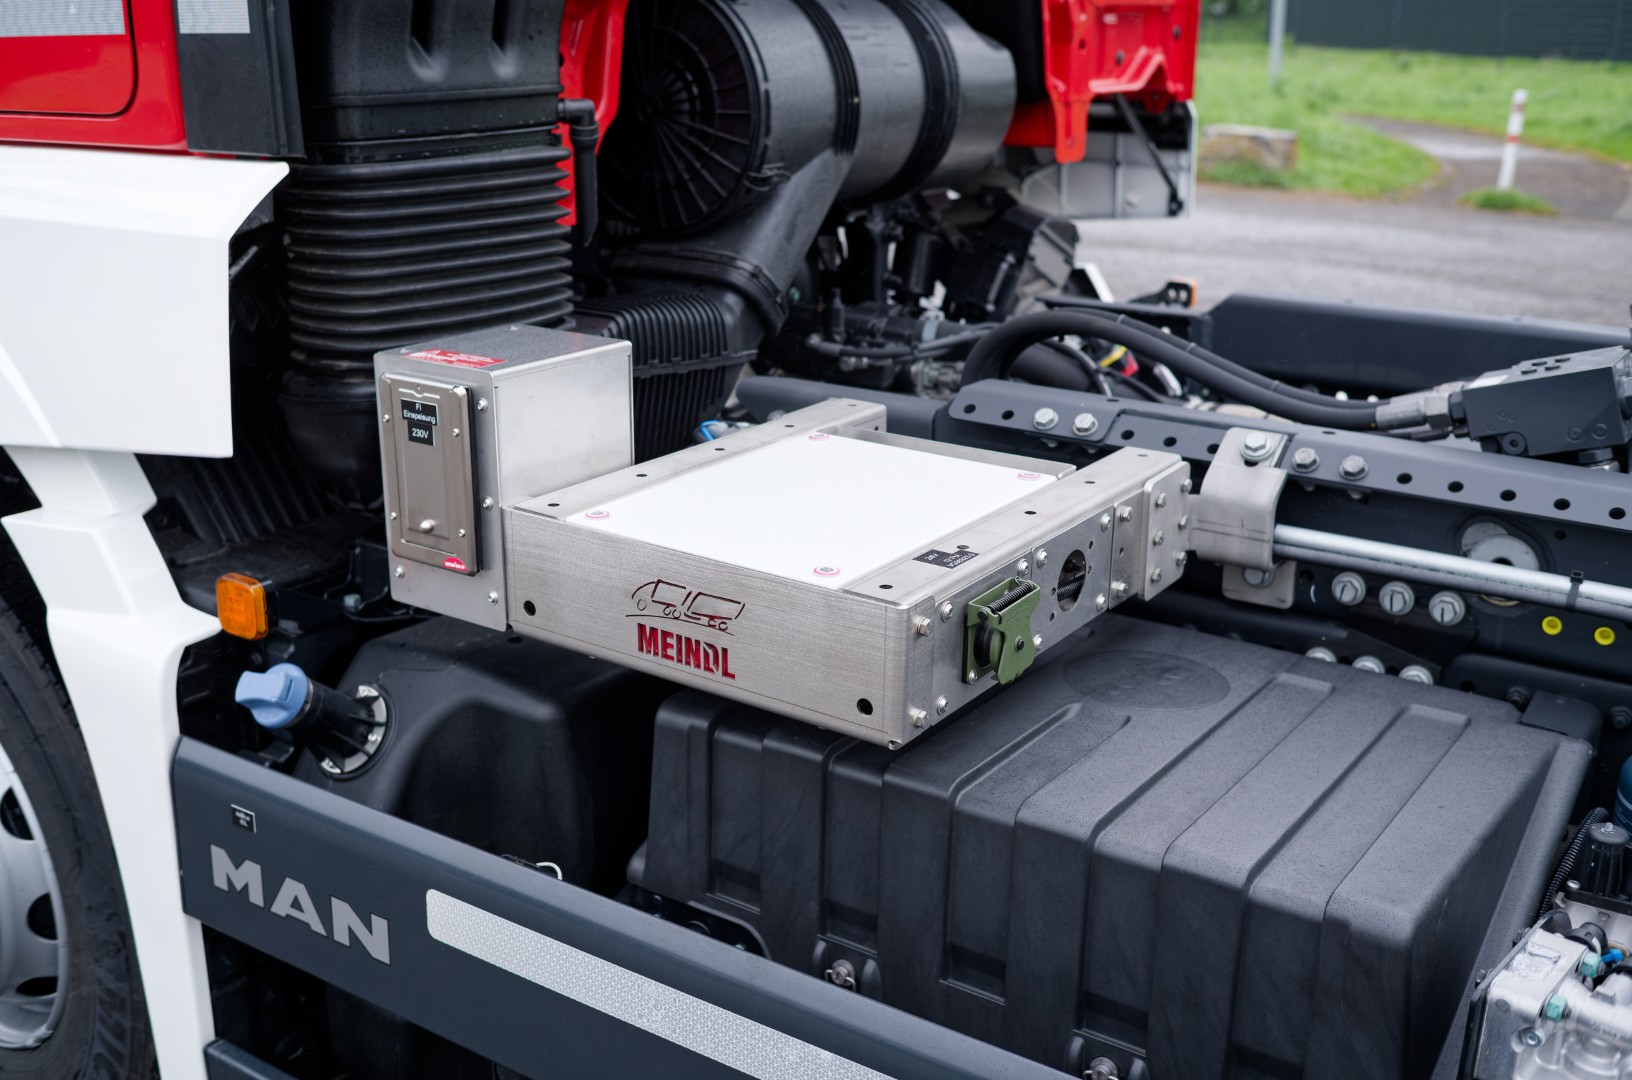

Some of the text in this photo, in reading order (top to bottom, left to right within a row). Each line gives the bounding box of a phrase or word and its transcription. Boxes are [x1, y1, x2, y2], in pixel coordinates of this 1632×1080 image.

[403, 409, 436, 425] Einspeisung
[411, 427, 429, 439] 230V
[637, 622, 736, 681] MEINDL
[210, 843, 391, 966] MAN
